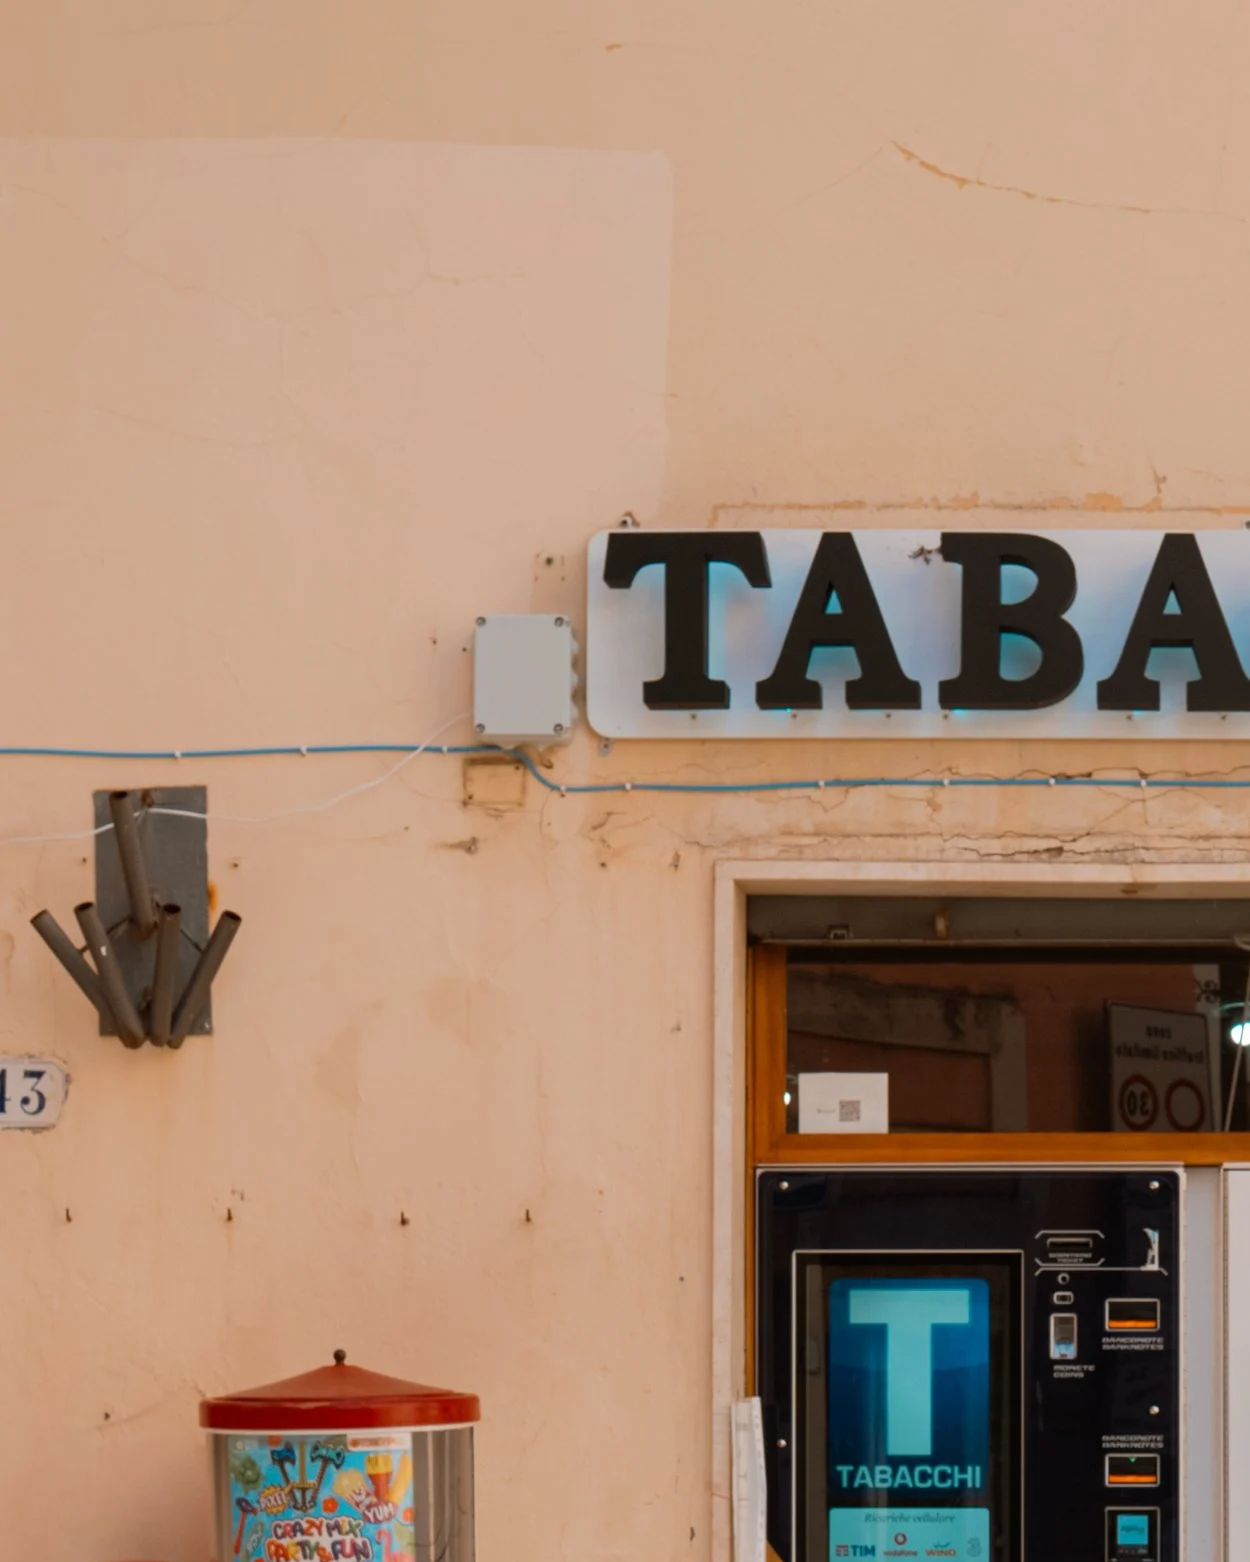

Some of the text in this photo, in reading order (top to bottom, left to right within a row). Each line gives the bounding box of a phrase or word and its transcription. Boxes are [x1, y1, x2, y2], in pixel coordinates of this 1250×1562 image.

[848, 1289, 970, 1456] T
[836, 1464, 981, 1489] TABACCHI
[365, 1503, 395, 1523] YUM
[273, 1518, 363, 1540] CRAZY MIX
[850, 1544, 876, 1557] TIM
[884, 1549, 918, 1557] vodafone
[925, 1549, 957, 1557] WIND
